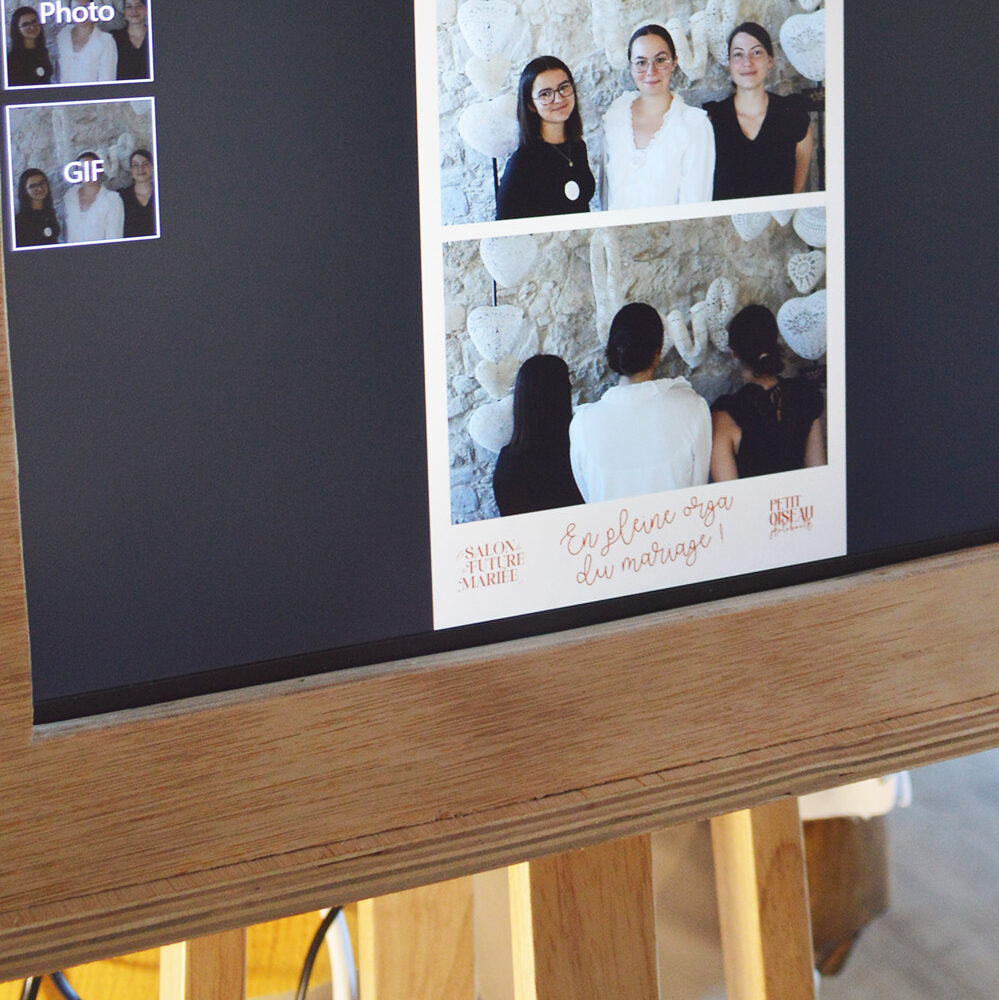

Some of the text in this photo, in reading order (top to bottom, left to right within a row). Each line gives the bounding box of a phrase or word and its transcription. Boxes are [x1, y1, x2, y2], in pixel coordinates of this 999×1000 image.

[39, 1, 115, 26] Photo
[63, 159, 105, 185] GIF
[769, 494, 802, 511] PETIT
[560, 495, 734, 557] En pleine orga
[769, 504, 814, 526] OISEAU
[464, 539, 516, 559] SALON
[576, 554, 615, 586] du
[621, 534, 712, 573] mariage
[467, 552, 525, 574] FUTURE
